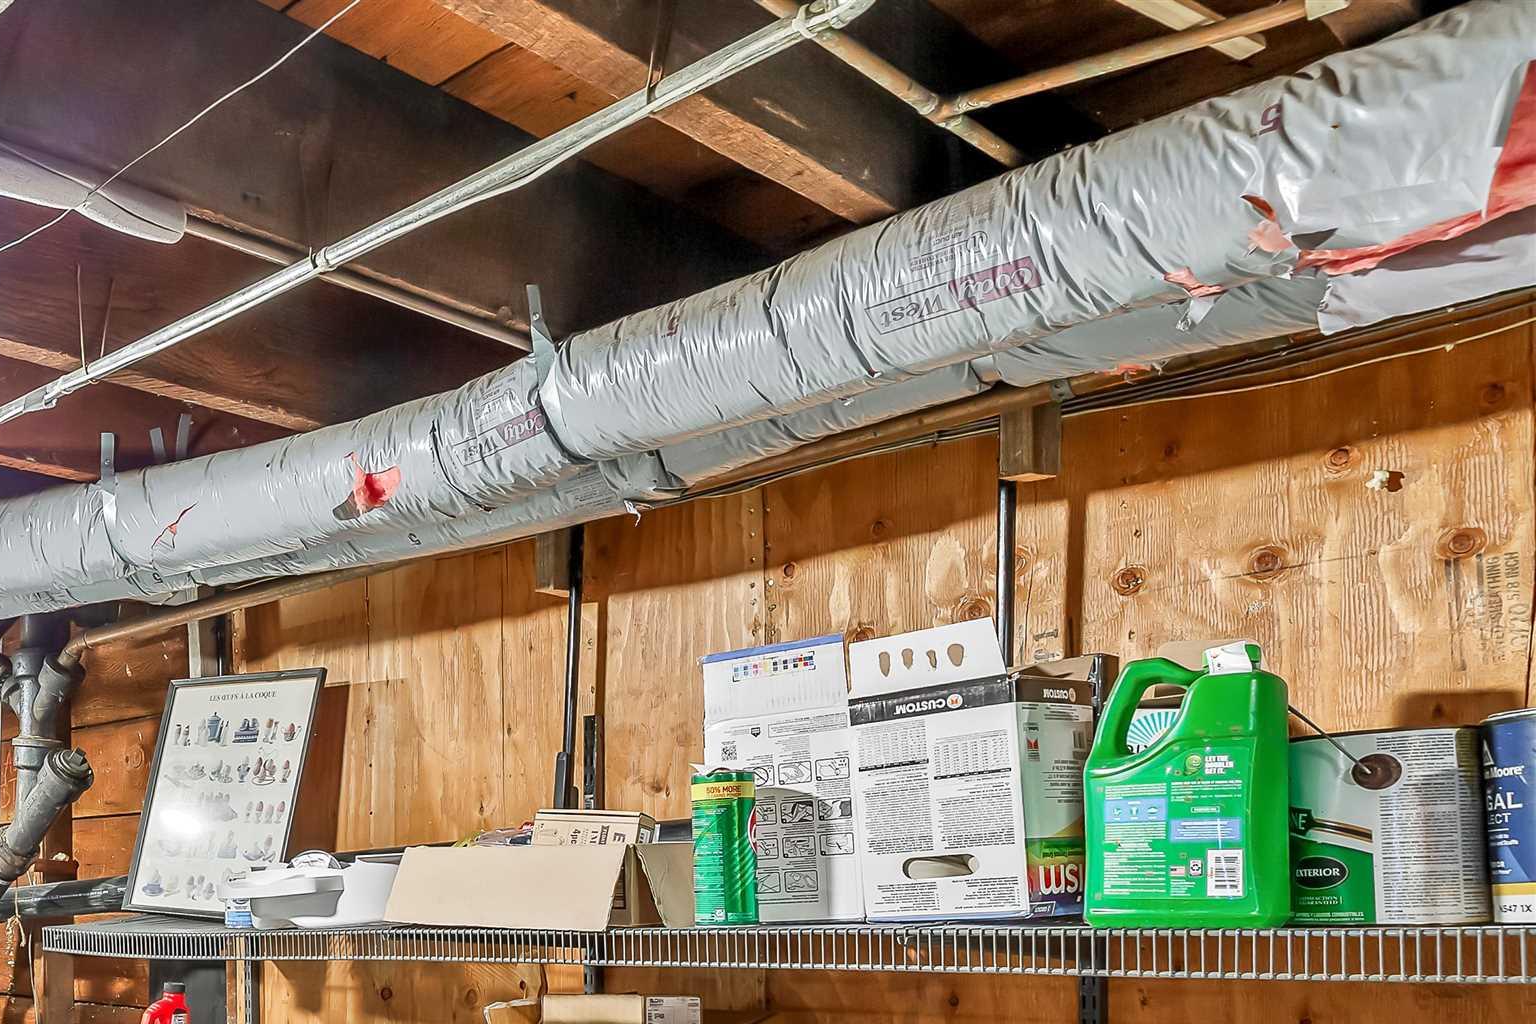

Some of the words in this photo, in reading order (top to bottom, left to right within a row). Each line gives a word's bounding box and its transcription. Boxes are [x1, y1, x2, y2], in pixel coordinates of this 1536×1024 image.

[880, 294, 946, 328] West
[504, 413, 545, 441] Cody
[1504, 551, 1520, 579] INCH
[894, 698, 946, 716] CUSTOM
[722, 785, 742, 794] MORE
[1487, 792, 1523, 810] GAL
[1039, 864, 1083, 902] ism
